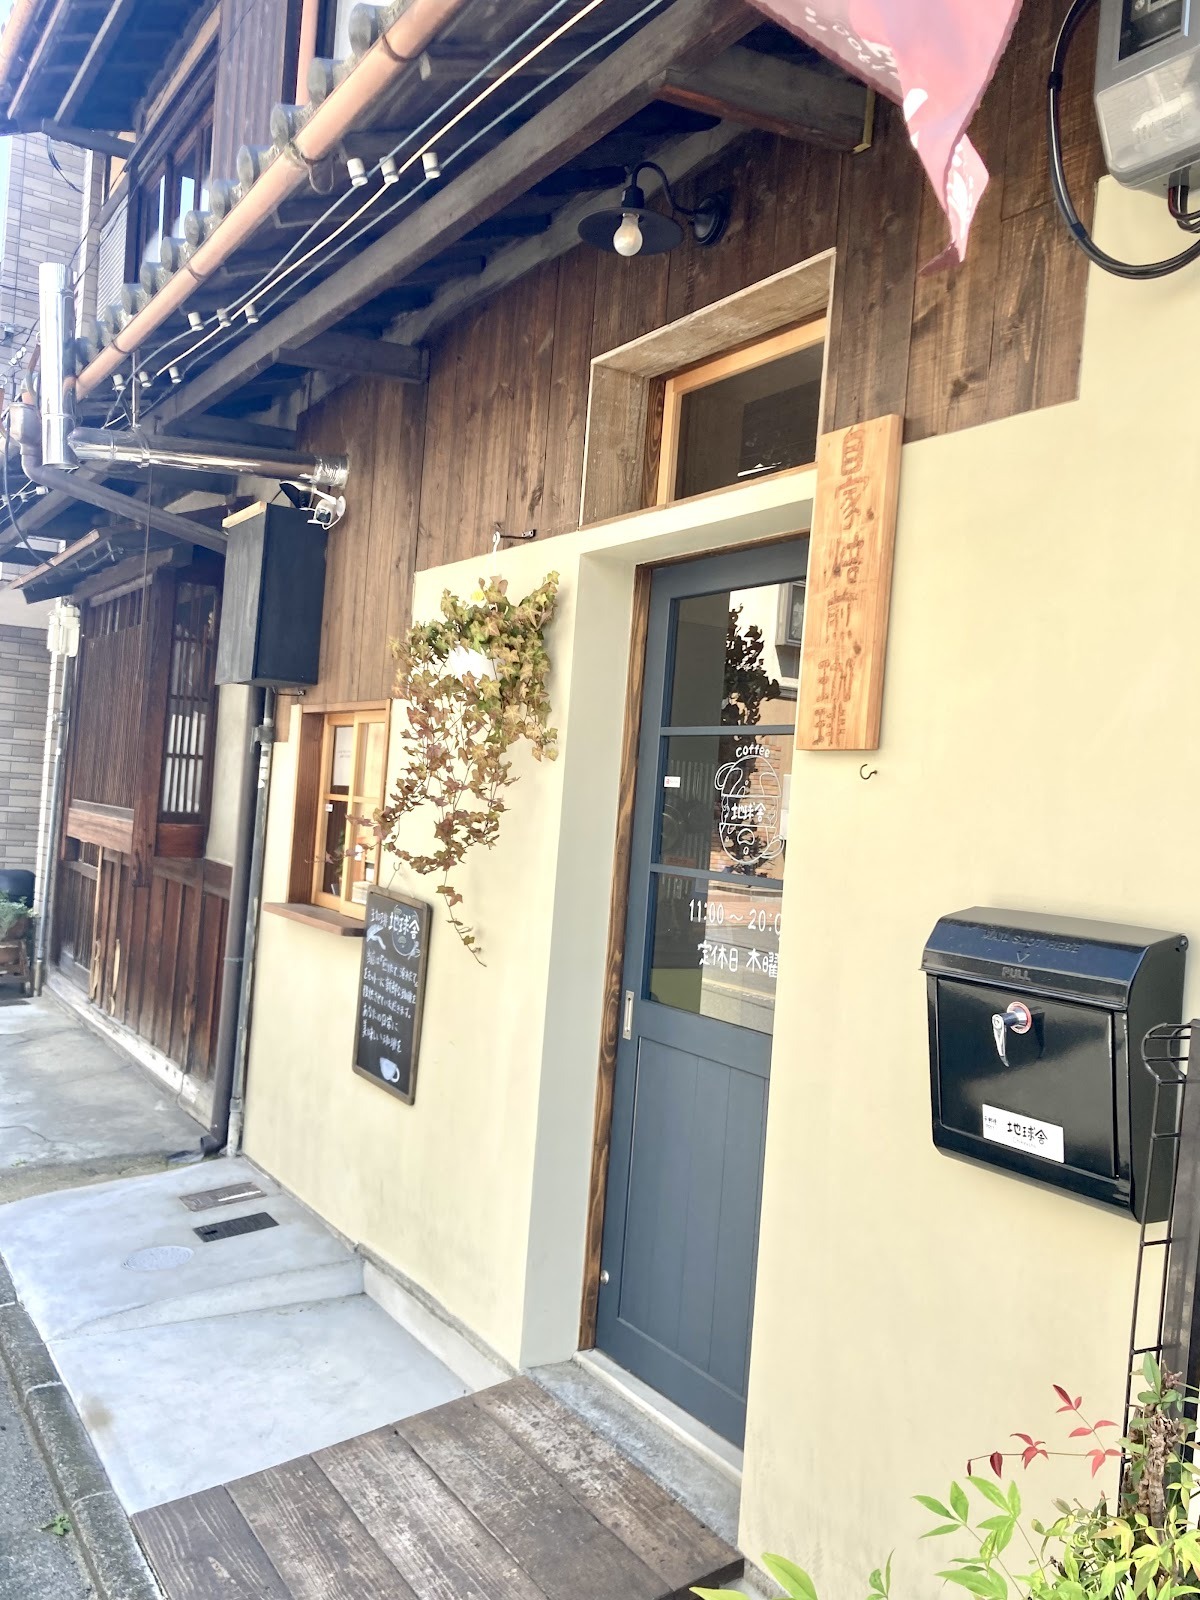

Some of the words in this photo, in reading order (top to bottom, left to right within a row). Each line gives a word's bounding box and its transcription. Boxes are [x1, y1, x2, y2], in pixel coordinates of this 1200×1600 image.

[811, 424, 869, 747] 自家焙煎珈琲
[735, 743, 770, 758] coffee
[689, 899, 724, 924] 11:00
[1012, 935, 1046, 948] SLOT
[697, 940, 738, 972] 定休日
[745, 948, 779, 978] 木曜
[1001, 966, 1031, 983] PULL
